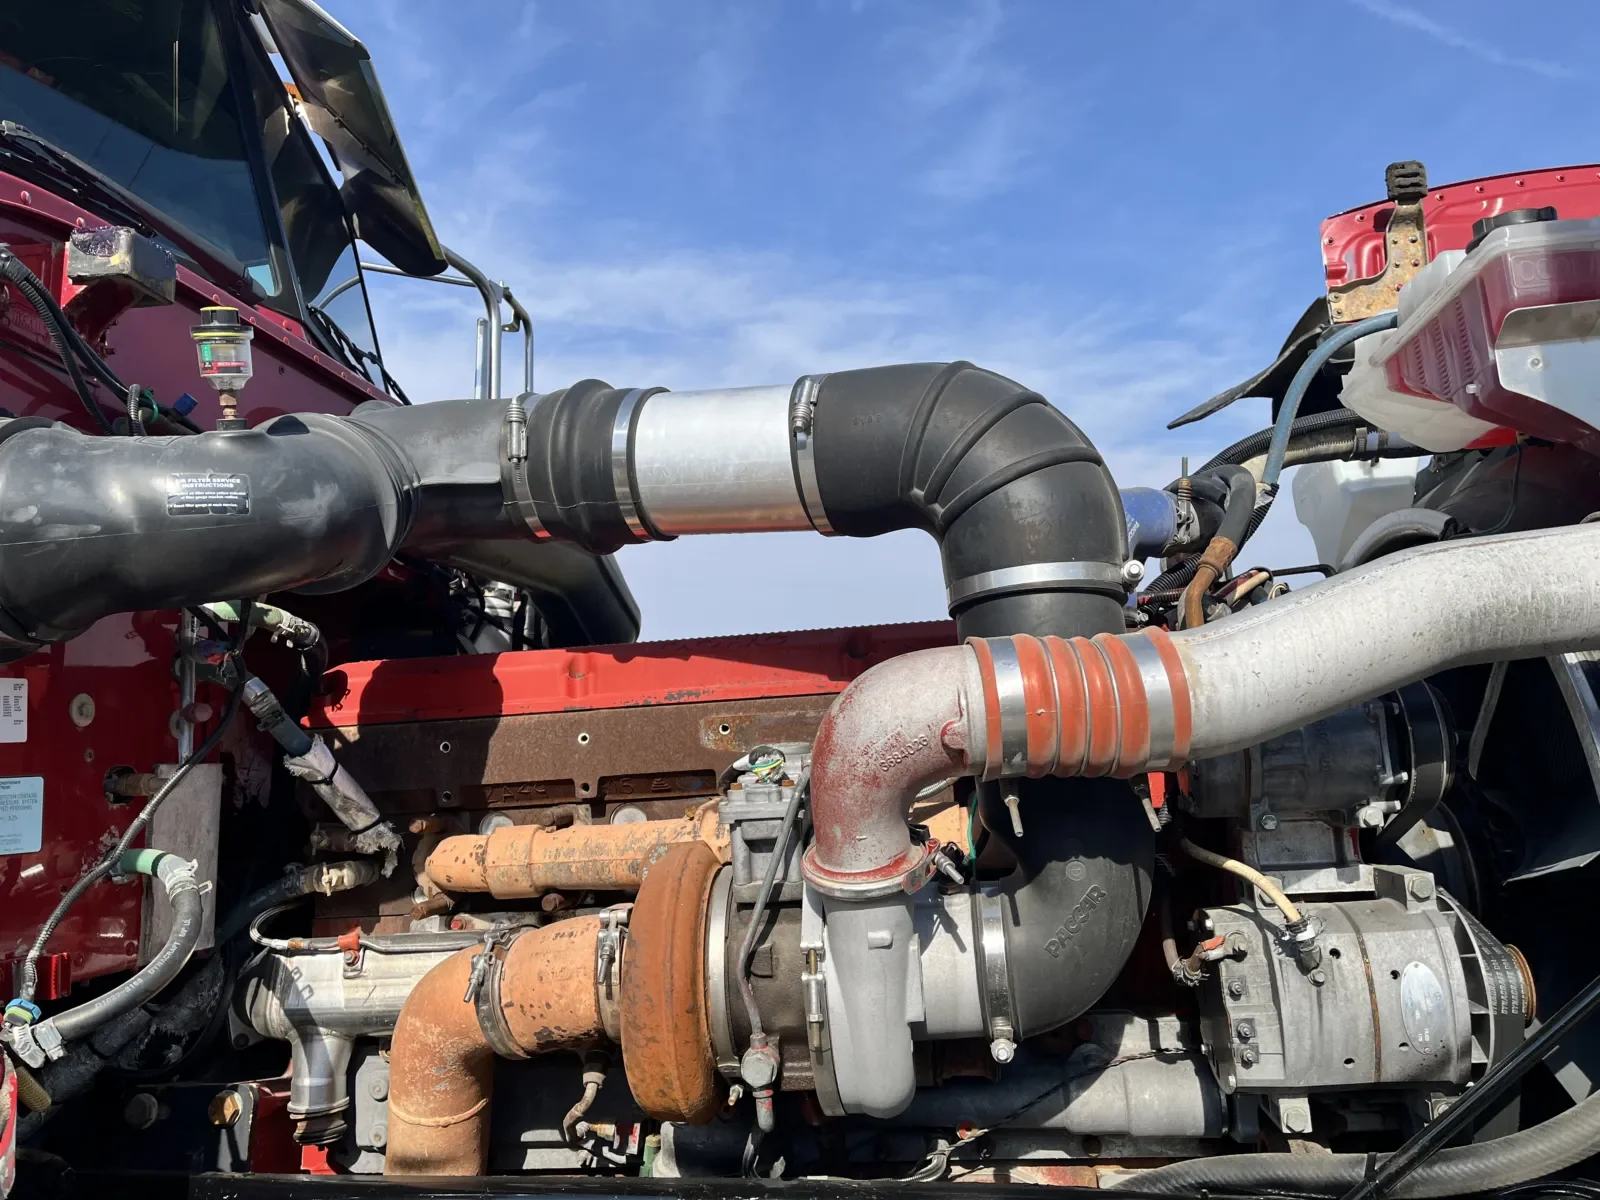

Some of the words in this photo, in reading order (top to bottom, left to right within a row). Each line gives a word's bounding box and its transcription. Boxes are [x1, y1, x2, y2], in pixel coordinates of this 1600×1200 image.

[1044, 884, 1107, 958] PACCAR
[148, 941, 181, 974] DYNACRAFT
[1496, 971, 1509, 1015] DYNACRAFT
[1506, 970, 1519, 1015] DYNACRAFT
